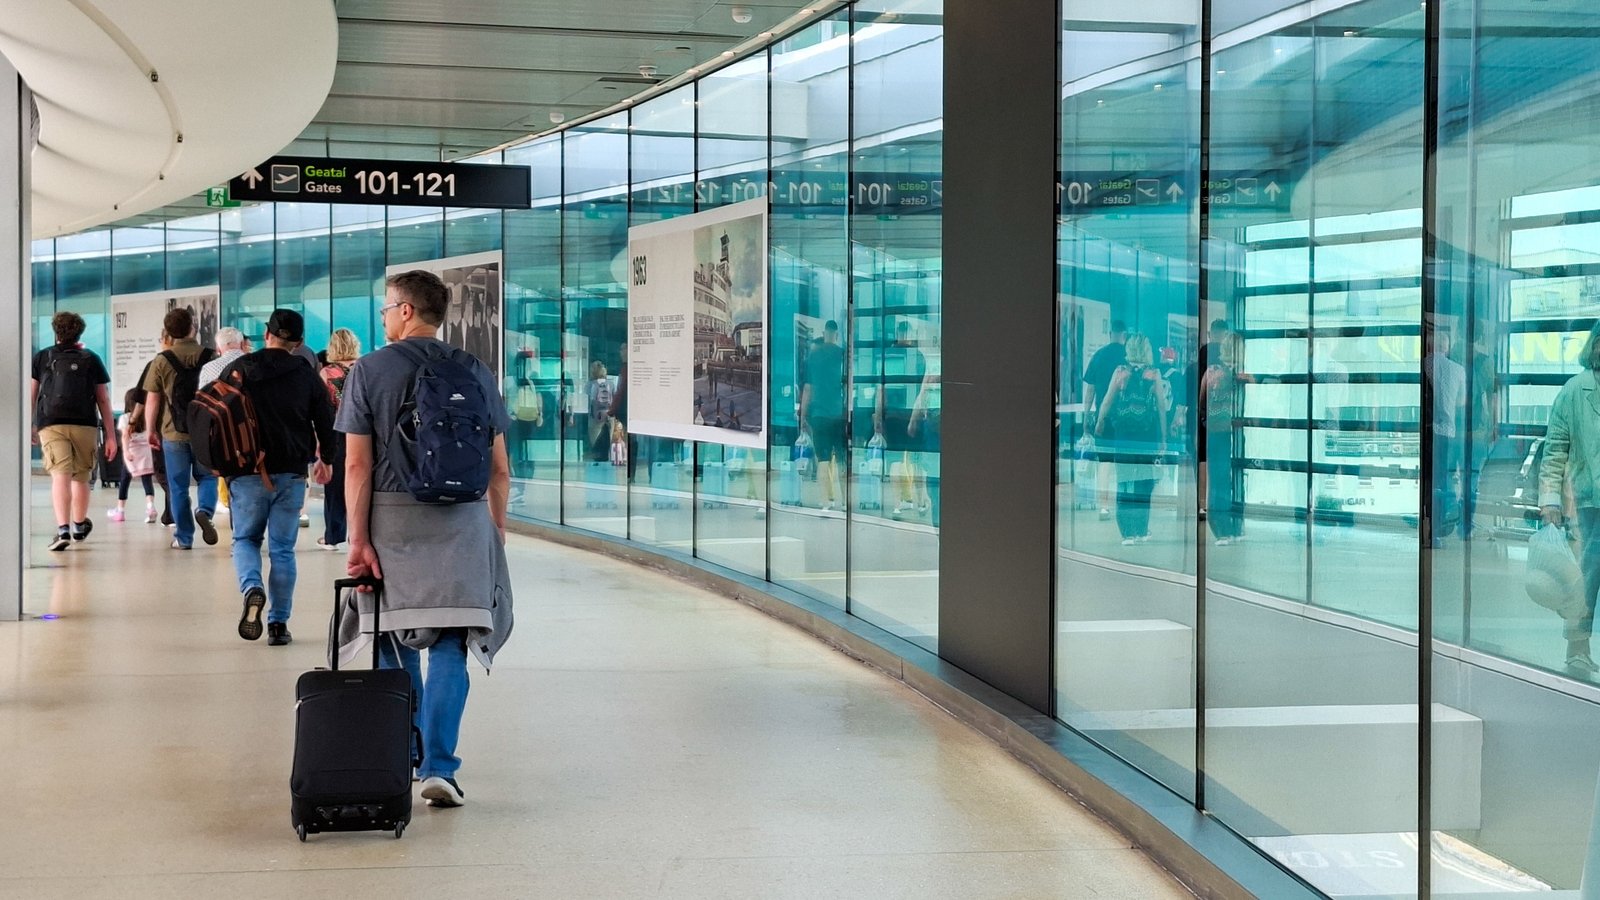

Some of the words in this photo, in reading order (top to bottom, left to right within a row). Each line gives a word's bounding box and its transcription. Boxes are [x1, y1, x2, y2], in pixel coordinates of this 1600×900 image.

[305, 166, 346, 178] Geataí
[305, 181, 342, 193] Gates
[354, 170, 456, 196] 101-121
[633, 255, 646, 286] 1963
